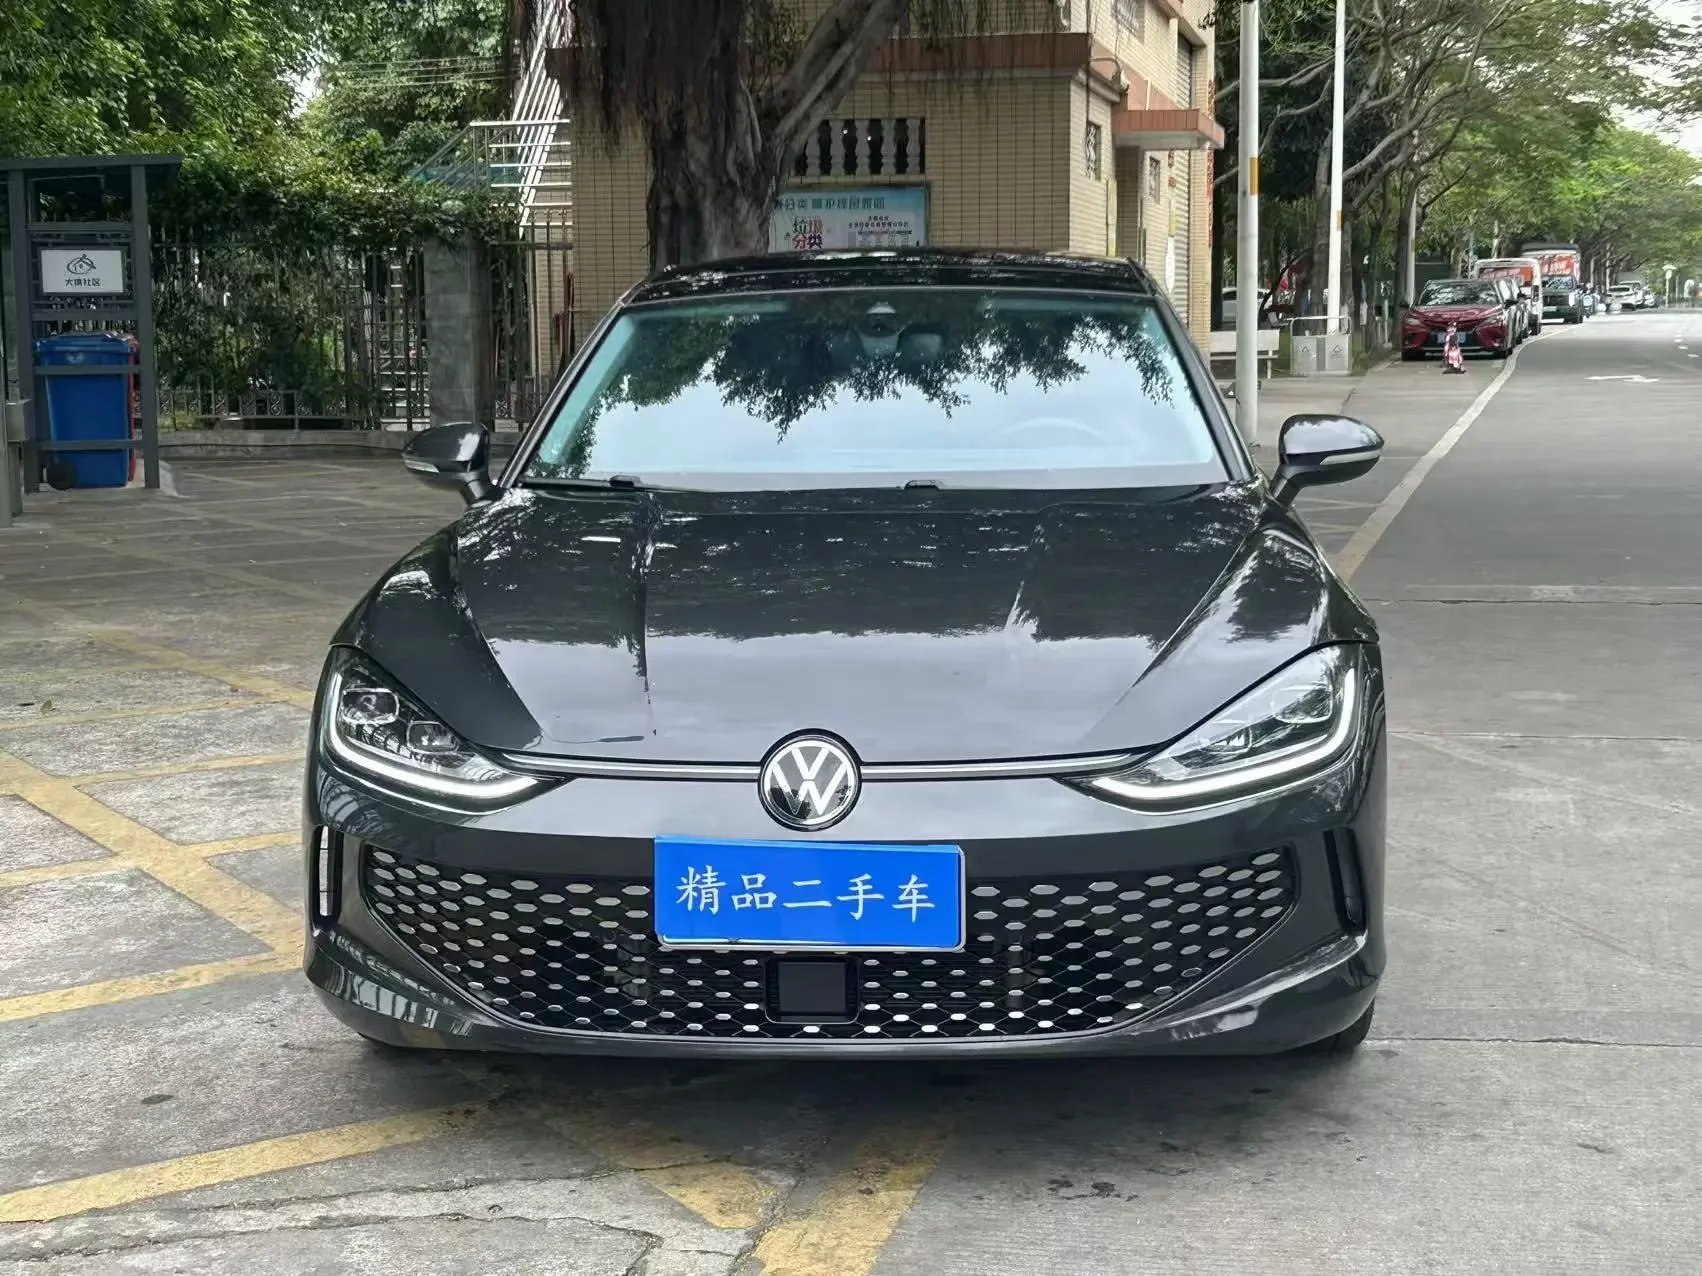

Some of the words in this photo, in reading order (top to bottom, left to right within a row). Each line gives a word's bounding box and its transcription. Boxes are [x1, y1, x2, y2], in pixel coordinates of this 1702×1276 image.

[793, 233, 824, 249] 分类
[675, 864, 936, 923] 精品二手车
